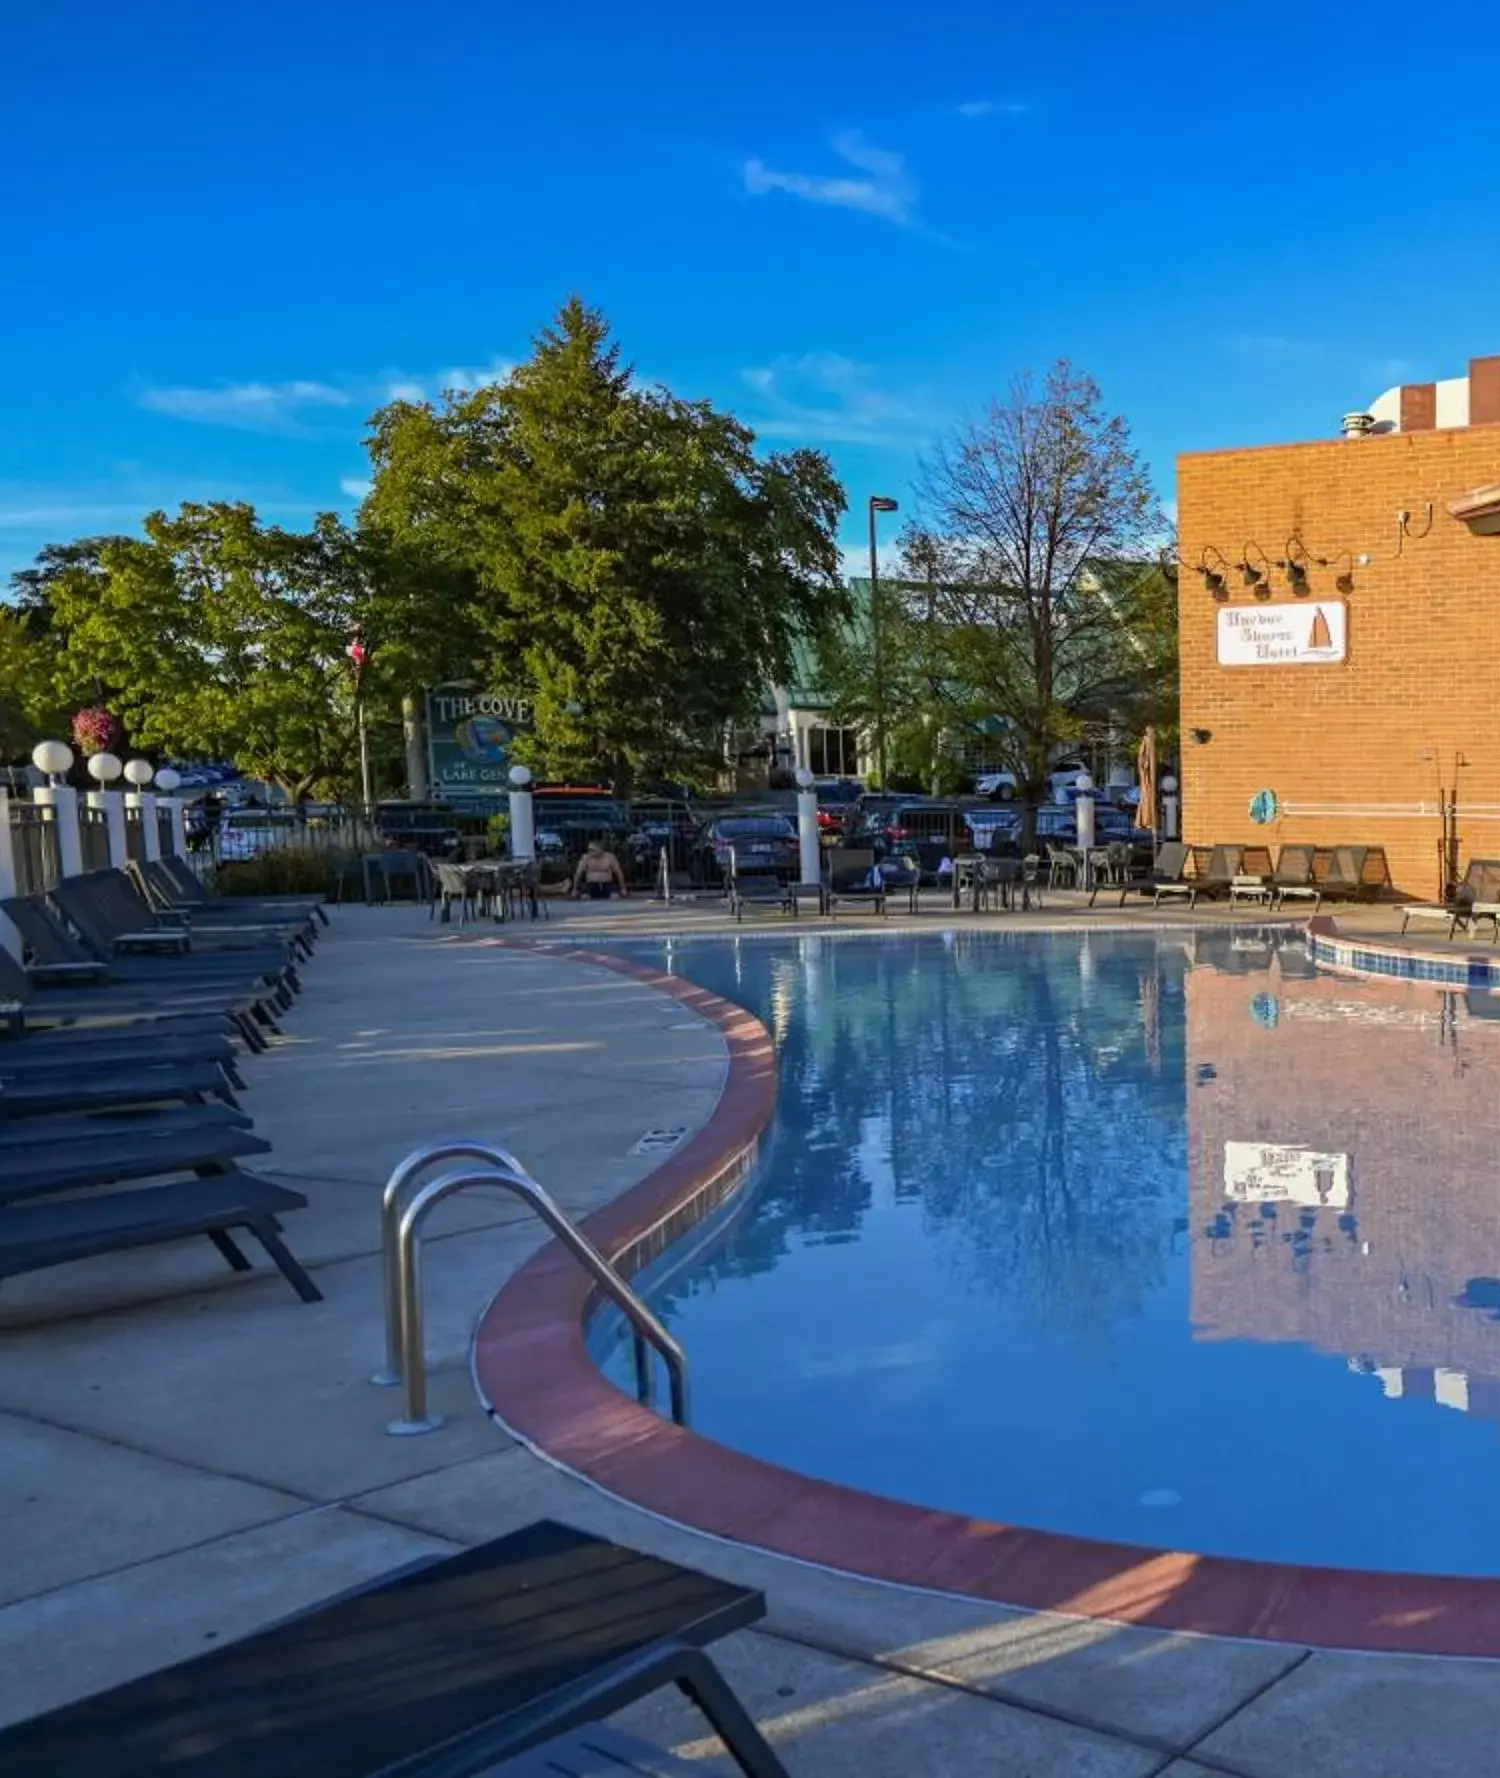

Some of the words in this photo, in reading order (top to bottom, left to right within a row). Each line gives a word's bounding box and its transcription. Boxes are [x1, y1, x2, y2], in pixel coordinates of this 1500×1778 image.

[435, 697, 477, 721] THE
[480, 699, 530, 722] COVE
[442, 769, 475, 780] LAKE
[480, 769, 506, 780] GEN
